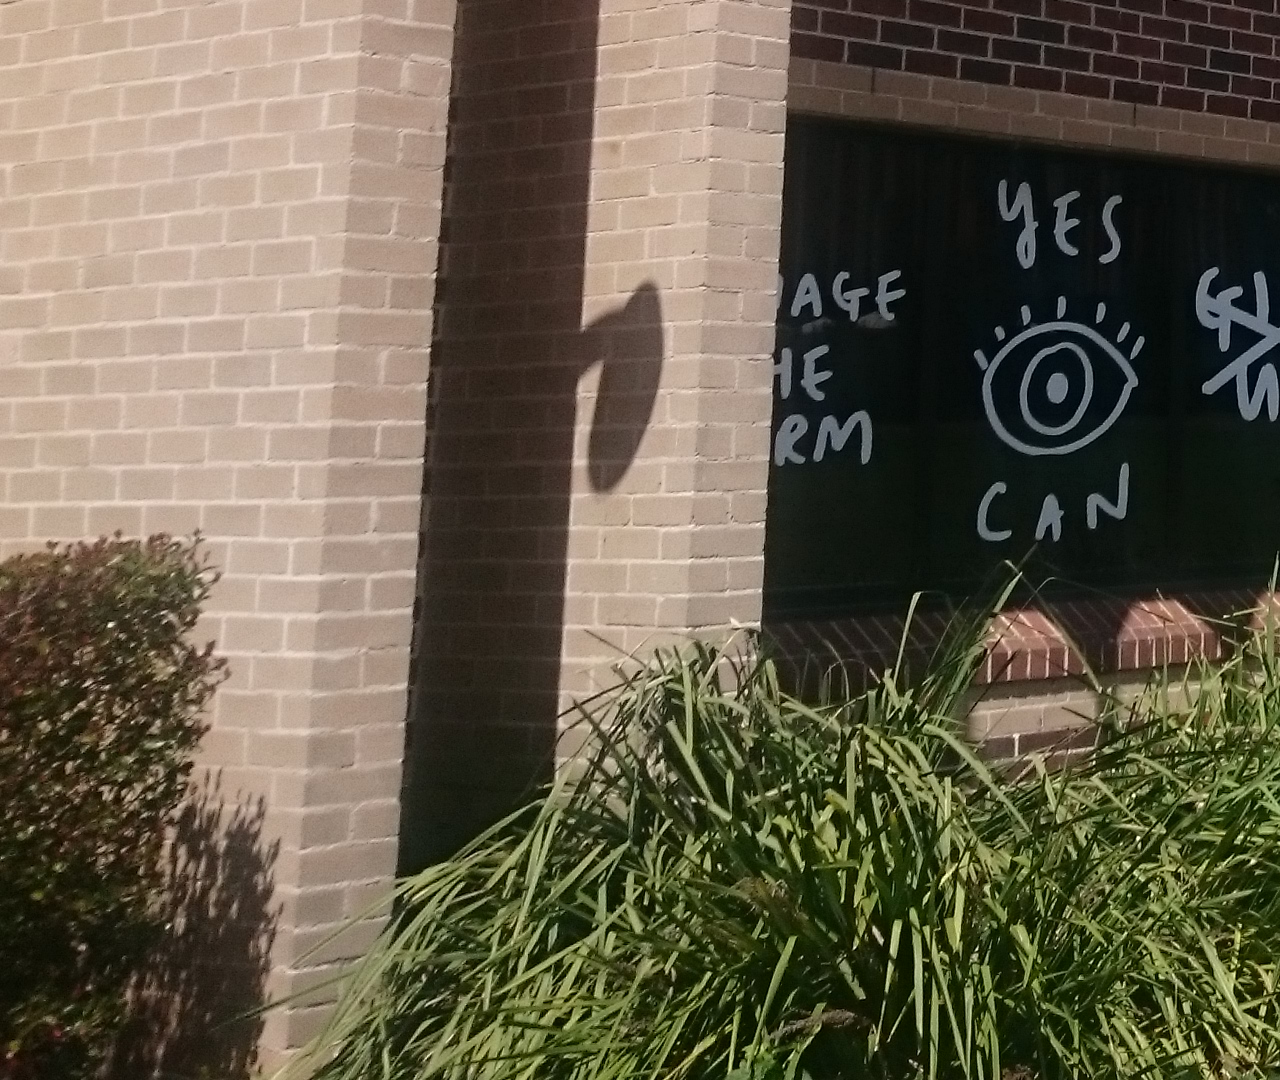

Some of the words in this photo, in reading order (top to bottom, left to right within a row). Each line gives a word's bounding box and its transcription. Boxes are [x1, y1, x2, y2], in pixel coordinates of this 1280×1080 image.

[997, 179, 1123, 269] YES
[777, 270, 907, 322] AGE
[976, 462, 1130, 542] CAN
